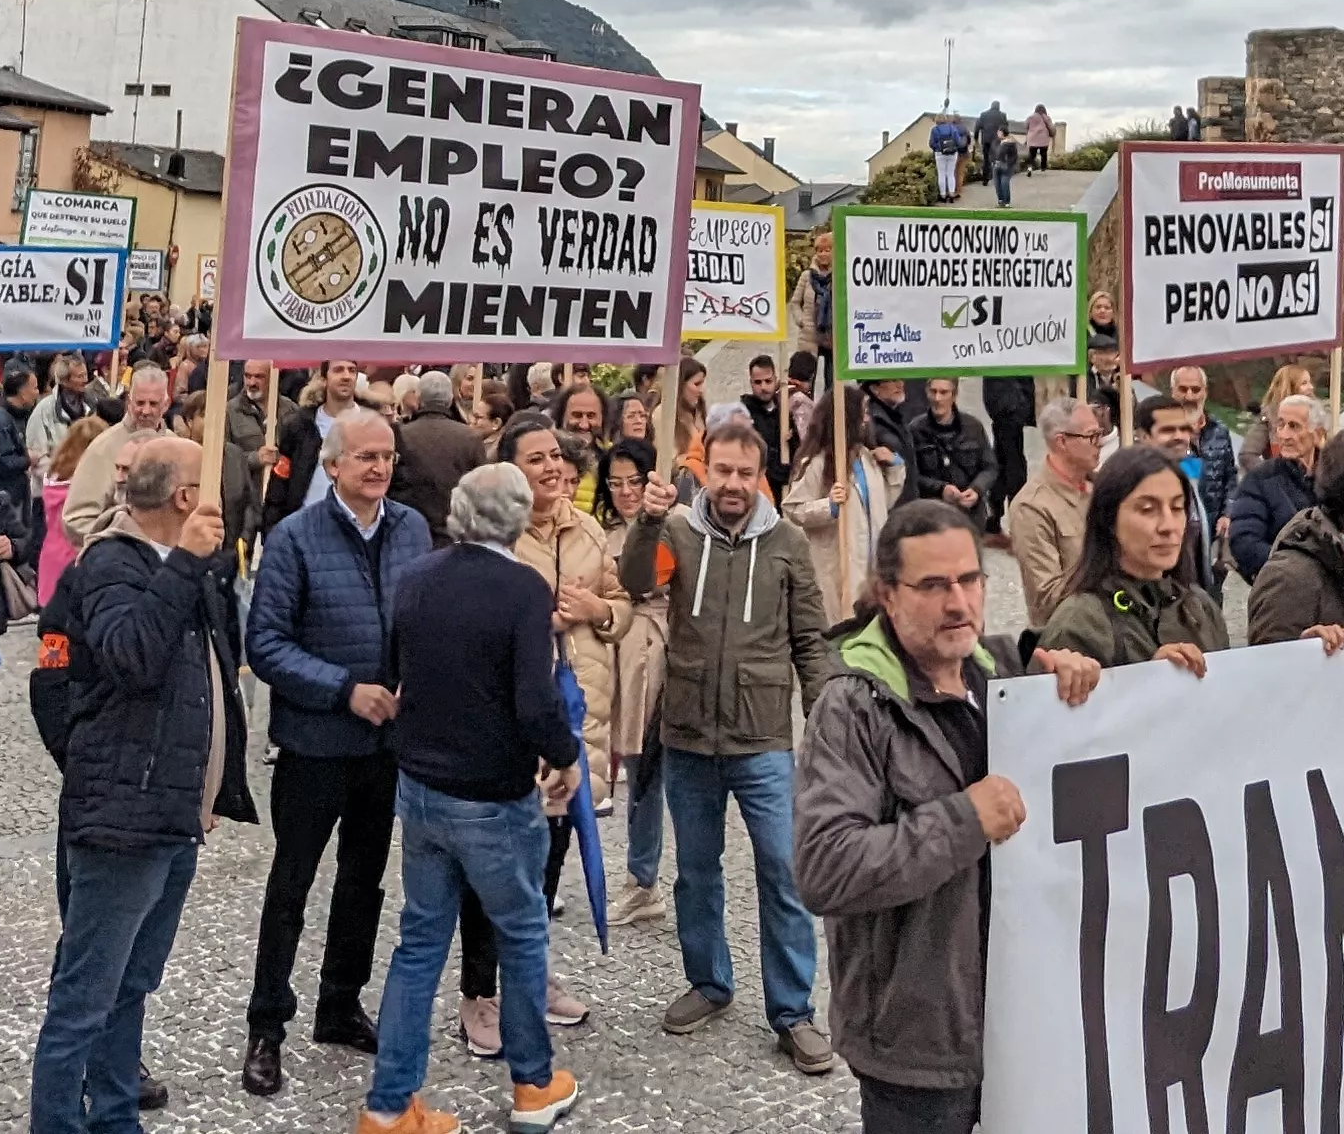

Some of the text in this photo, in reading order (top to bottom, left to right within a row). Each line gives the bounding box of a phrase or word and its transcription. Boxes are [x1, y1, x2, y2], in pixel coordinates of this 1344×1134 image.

[274, 52, 672, 146] ¿GENERAN
[306, 124, 646, 201] EMPLEO?
[1198, 171, 1298, 191] ProMonumenta
[31, 211, 127, 226] QUE DESTRUYE SU SUELO
[43, 197, 119, 212] LA COMARCA
[395, 195, 657, 278] NO ES VERDAD
[878, 224, 1048, 254] EL AUTOCONSUMO Y LAS
[1144, 199, 1332, 256] RENOVABLES SÍ
[64, 257, 109, 306] SI
[688, 253, 743, 282] ERDAD
[852, 253, 1073, 288] COMUNIDADES ENERGÉTICAS
[277, 290, 316, 326] PRADA
[321, 294, 357, 325] TOPE
[683, 294, 770, 316] FALSO
[1165, 261, 1317, 324] PERO NO ASÍ
[87, 308, 102, 321] NO
[382, 279, 653, 339] MIENTEN
[971, 295, 1003, 326] SI
[82, 323, 100, 338] ASÍ
[854, 322, 921, 342] Tierras Altas
[952, 314, 1067, 360] son la SOLUCIÓN
[855, 344, 914, 364] de Trevinca
